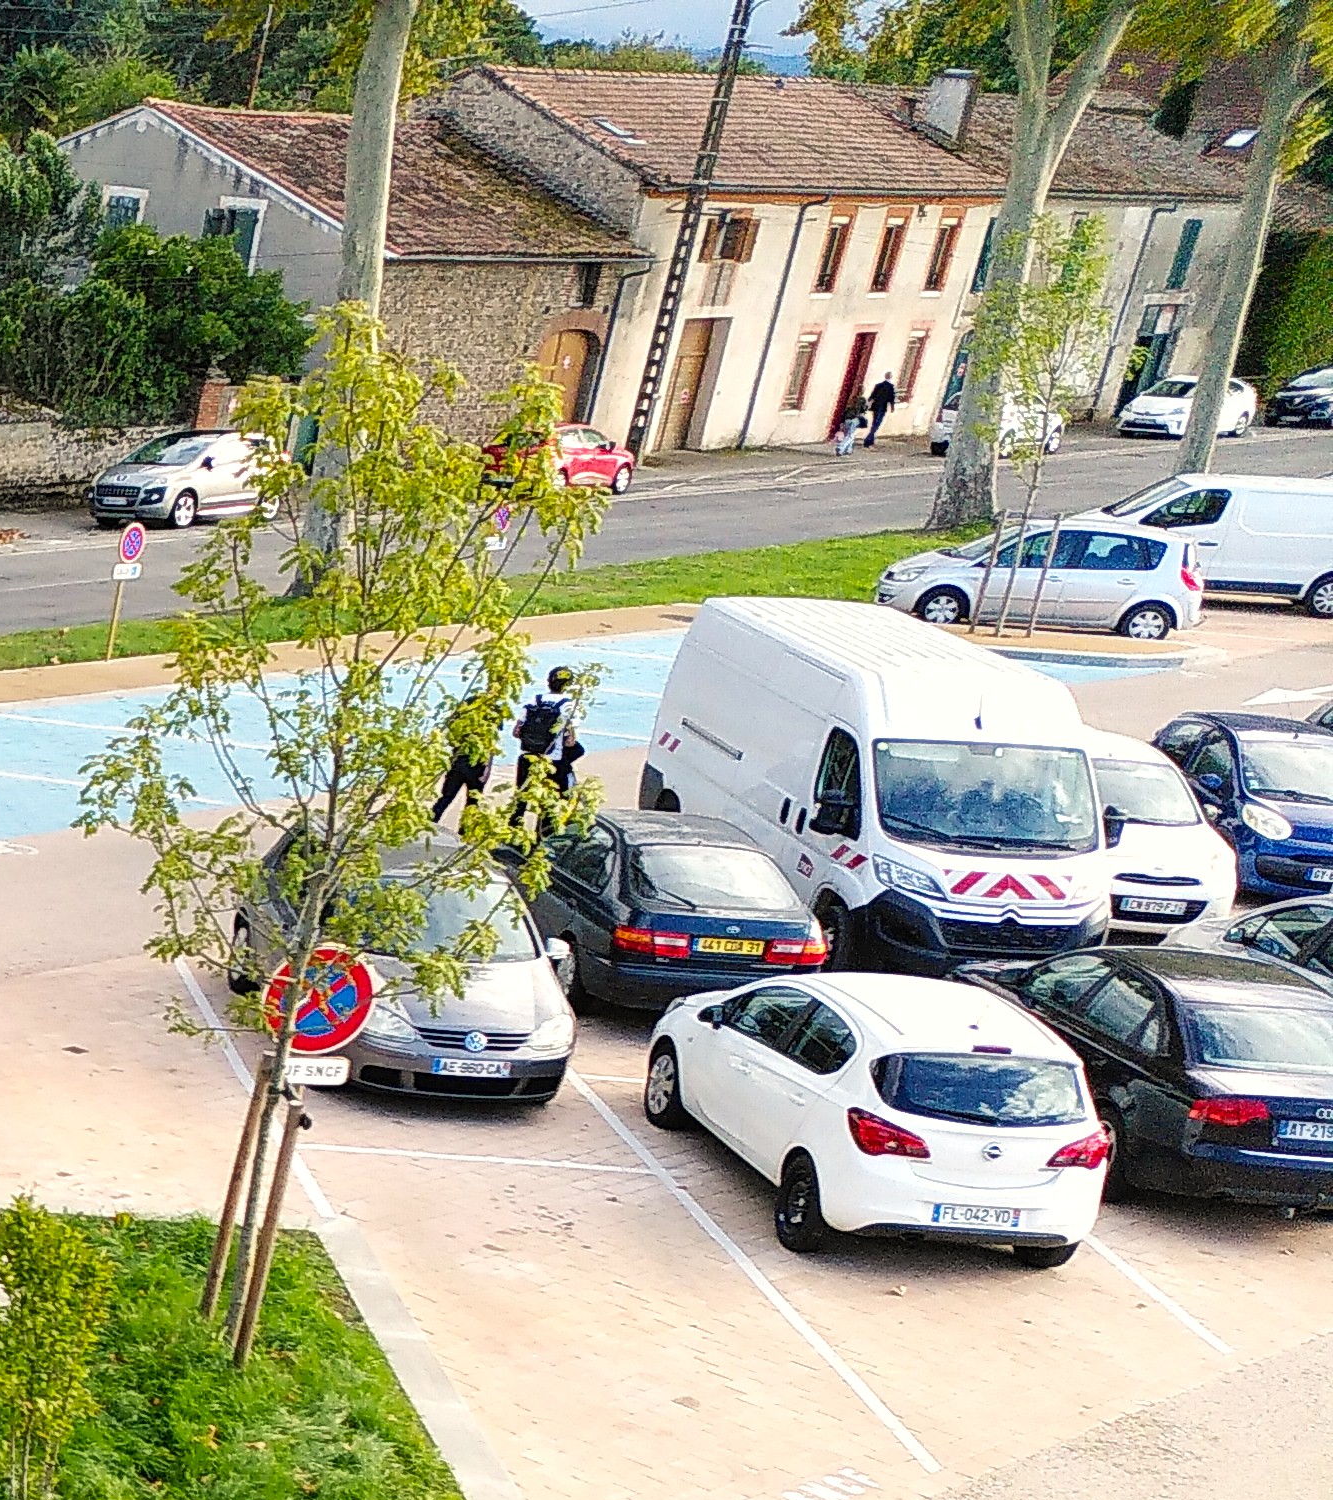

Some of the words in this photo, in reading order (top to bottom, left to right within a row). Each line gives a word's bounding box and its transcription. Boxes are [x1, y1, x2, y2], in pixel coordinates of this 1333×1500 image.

[701, 939, 721, 951] 441
[746, 941, 760, 953] 31
[305, 1065, 343, 1078] SNCF
[942, 1206, 1011, 1224] FL-042-VD
